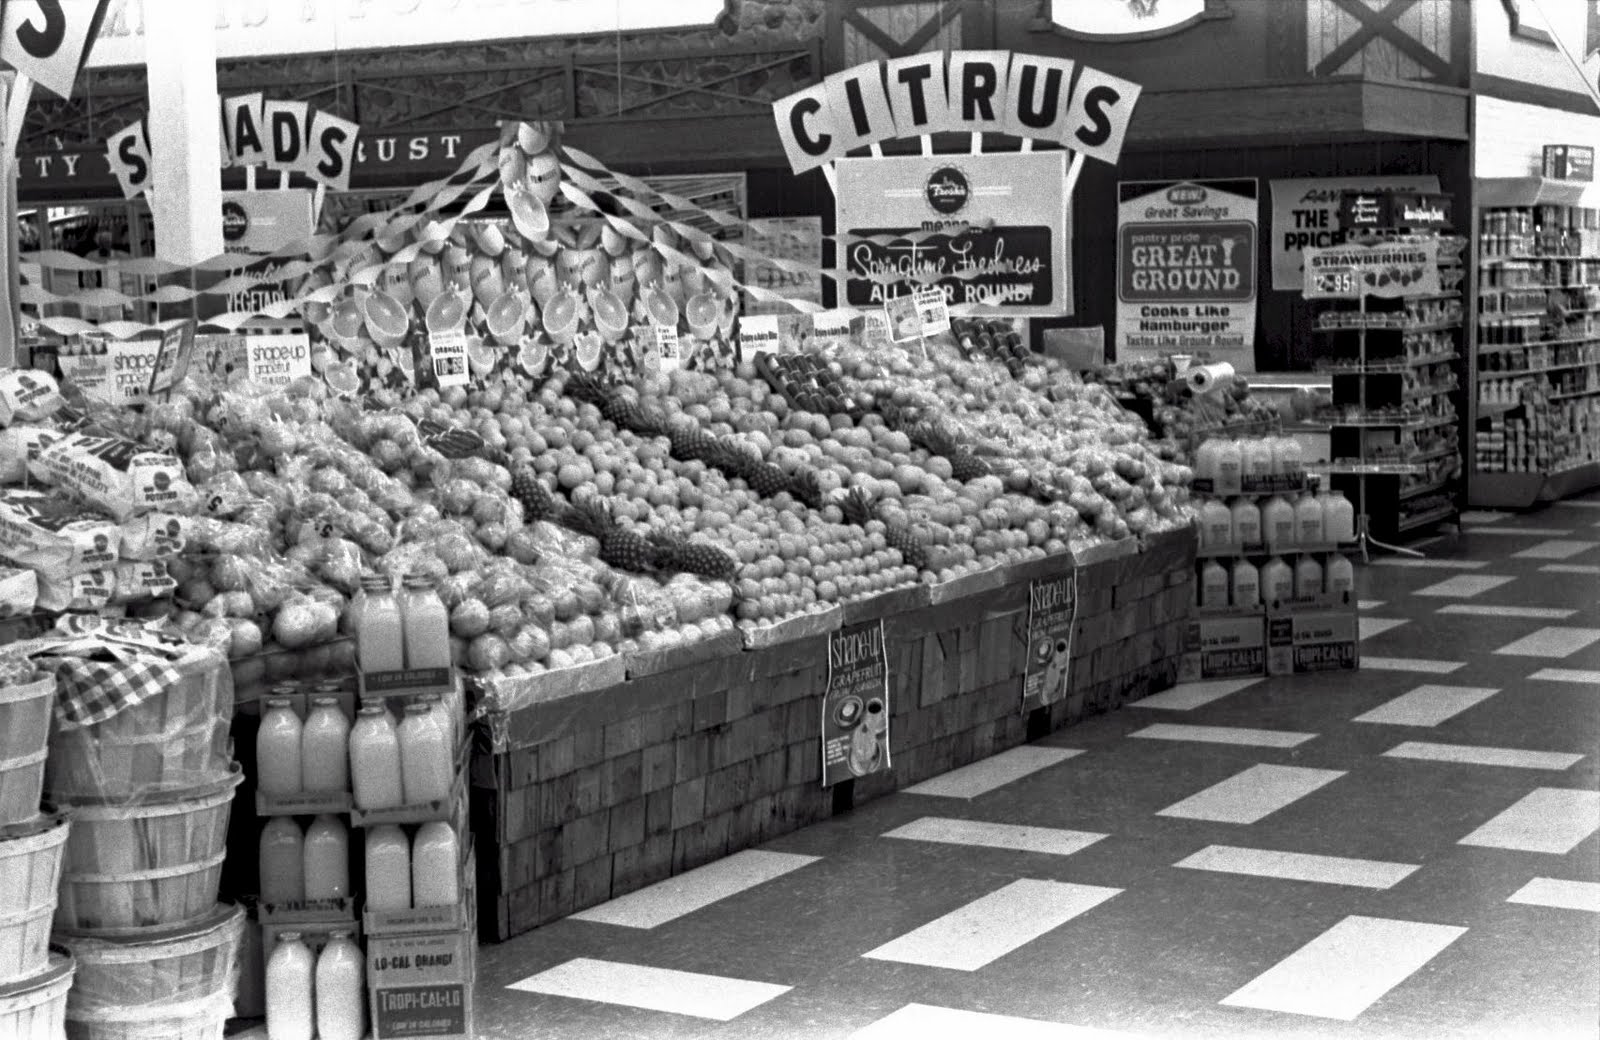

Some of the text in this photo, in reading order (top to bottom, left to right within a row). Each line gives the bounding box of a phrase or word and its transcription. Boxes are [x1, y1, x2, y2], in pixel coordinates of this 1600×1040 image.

[789, 61, 1121, 156] CITRUS
[118, 103, 347, 186] SADS
[1145, 206, 1229, 220] Great Savings
[1292, 209, 1329, 228] THE
[1131, 233, 1200, 245] pantry pride
[1132, 245, 1217, 267] GREAT
[1312, 252, 1427, 267] STRAWBERRIES
[1132, 268, 1240, 291] GROUND
[1141, 305, 1230, 317] Cooks Like
[1140, 320, 1230, 333] Hamburger
[252, 345, 306, 362] shape-up
[1033, 576, 1074, 614] shape-up
[832, 626, 881, 670] shape-up
[832, 661, 883, 690] GRAPEFRUIT
[374, 955, 410, 971] LO-CAL
